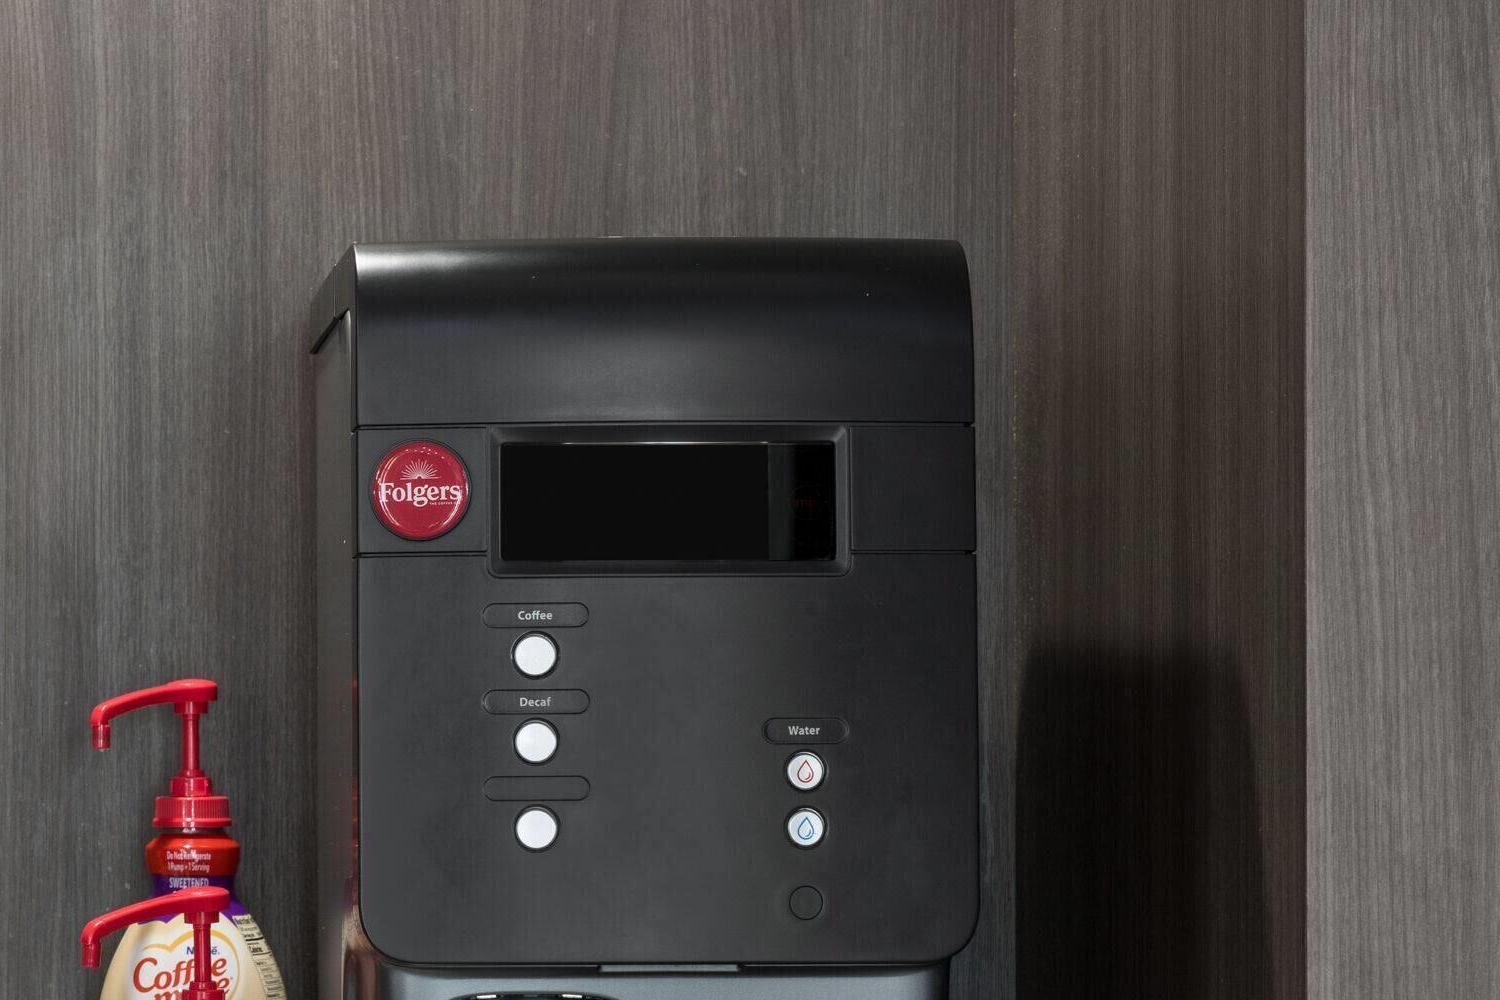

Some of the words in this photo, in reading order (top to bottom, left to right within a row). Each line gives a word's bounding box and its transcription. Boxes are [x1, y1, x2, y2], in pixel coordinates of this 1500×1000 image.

[379, 482, 463, 508] Folgers
[517, 609, 553, 622] Coffee
[518, 695, 552, 708] Decaf
[787, 724, 820, 737] Water
[133, 957, 228, 993] Coffe
